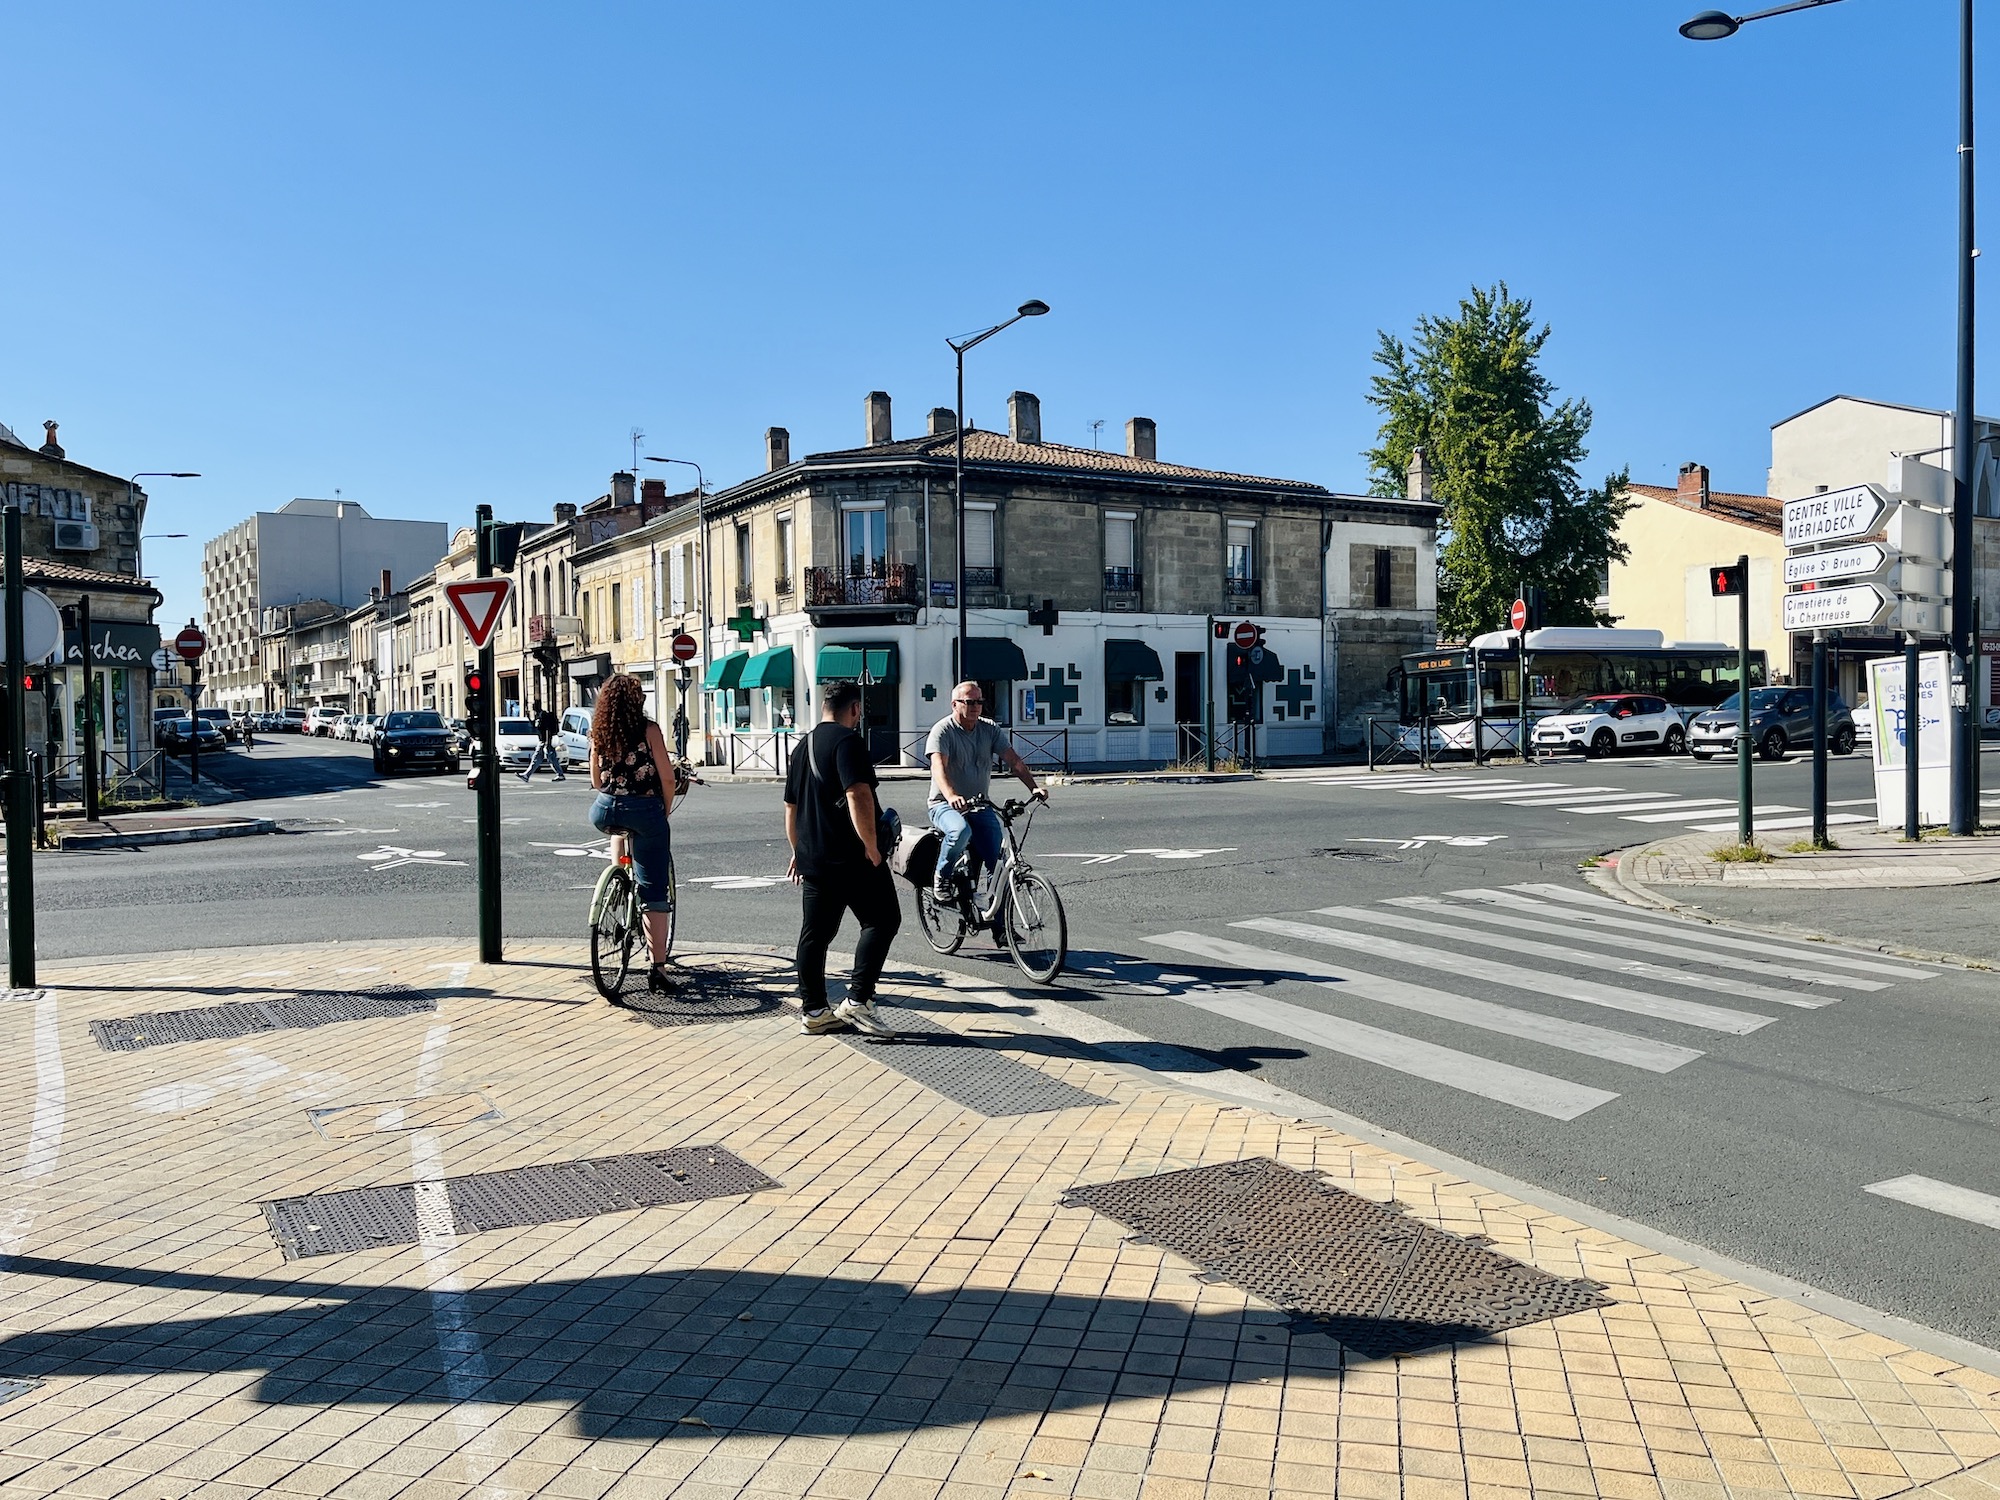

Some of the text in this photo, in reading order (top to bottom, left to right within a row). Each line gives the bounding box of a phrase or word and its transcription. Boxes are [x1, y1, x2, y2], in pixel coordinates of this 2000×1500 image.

[1788, 493, 1864, 522] CENTRE VILLE
[1788, 514, 1856, 540] MÉRIADECK
[1788, 557, 1861, 578] Église St Bruno
[1787, 594, 1848, 611] Cimetière de
[1787, 610, 1851, 624] la Chartreuse
[67, 630, 142, 661] achea
[1899, 681, 1938, 692] LAGE
[1899, 691, 1933, 701] RES
